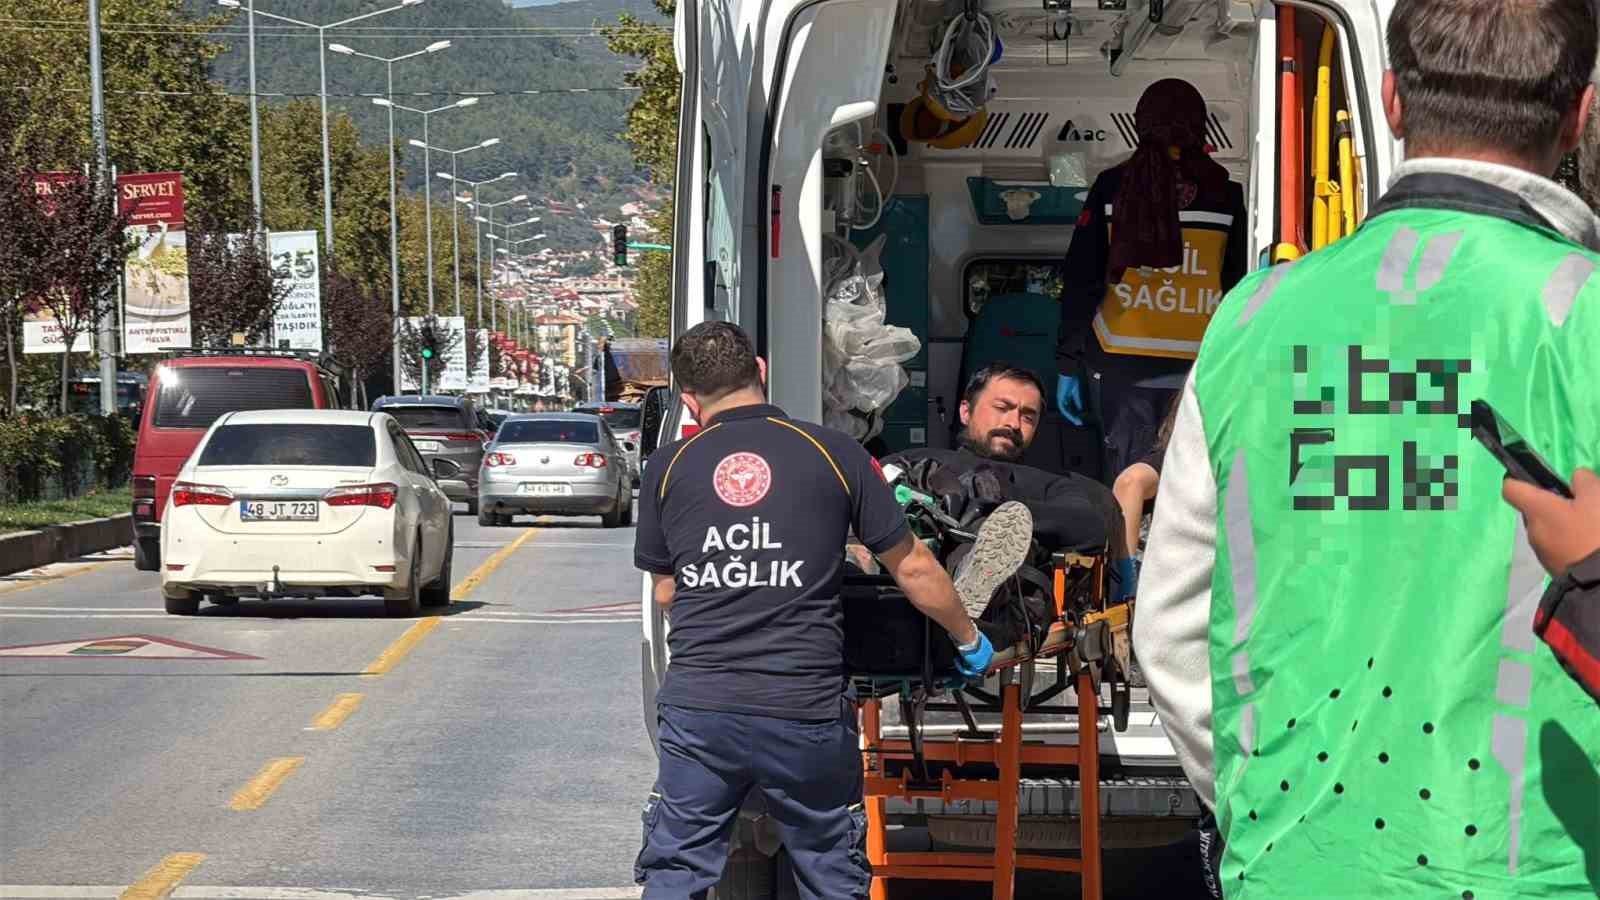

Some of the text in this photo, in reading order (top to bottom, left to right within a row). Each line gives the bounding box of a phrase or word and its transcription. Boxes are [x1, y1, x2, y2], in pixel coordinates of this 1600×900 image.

[123, 180, 176, 200] SERVET
[1115, 278, 1223, 315] SAĞLIK
[248, 503, 316, 515] 48 JT 723
[702, 516, 782, 552] ACİL
[682, 555, 804, 589] SAĞLIK
